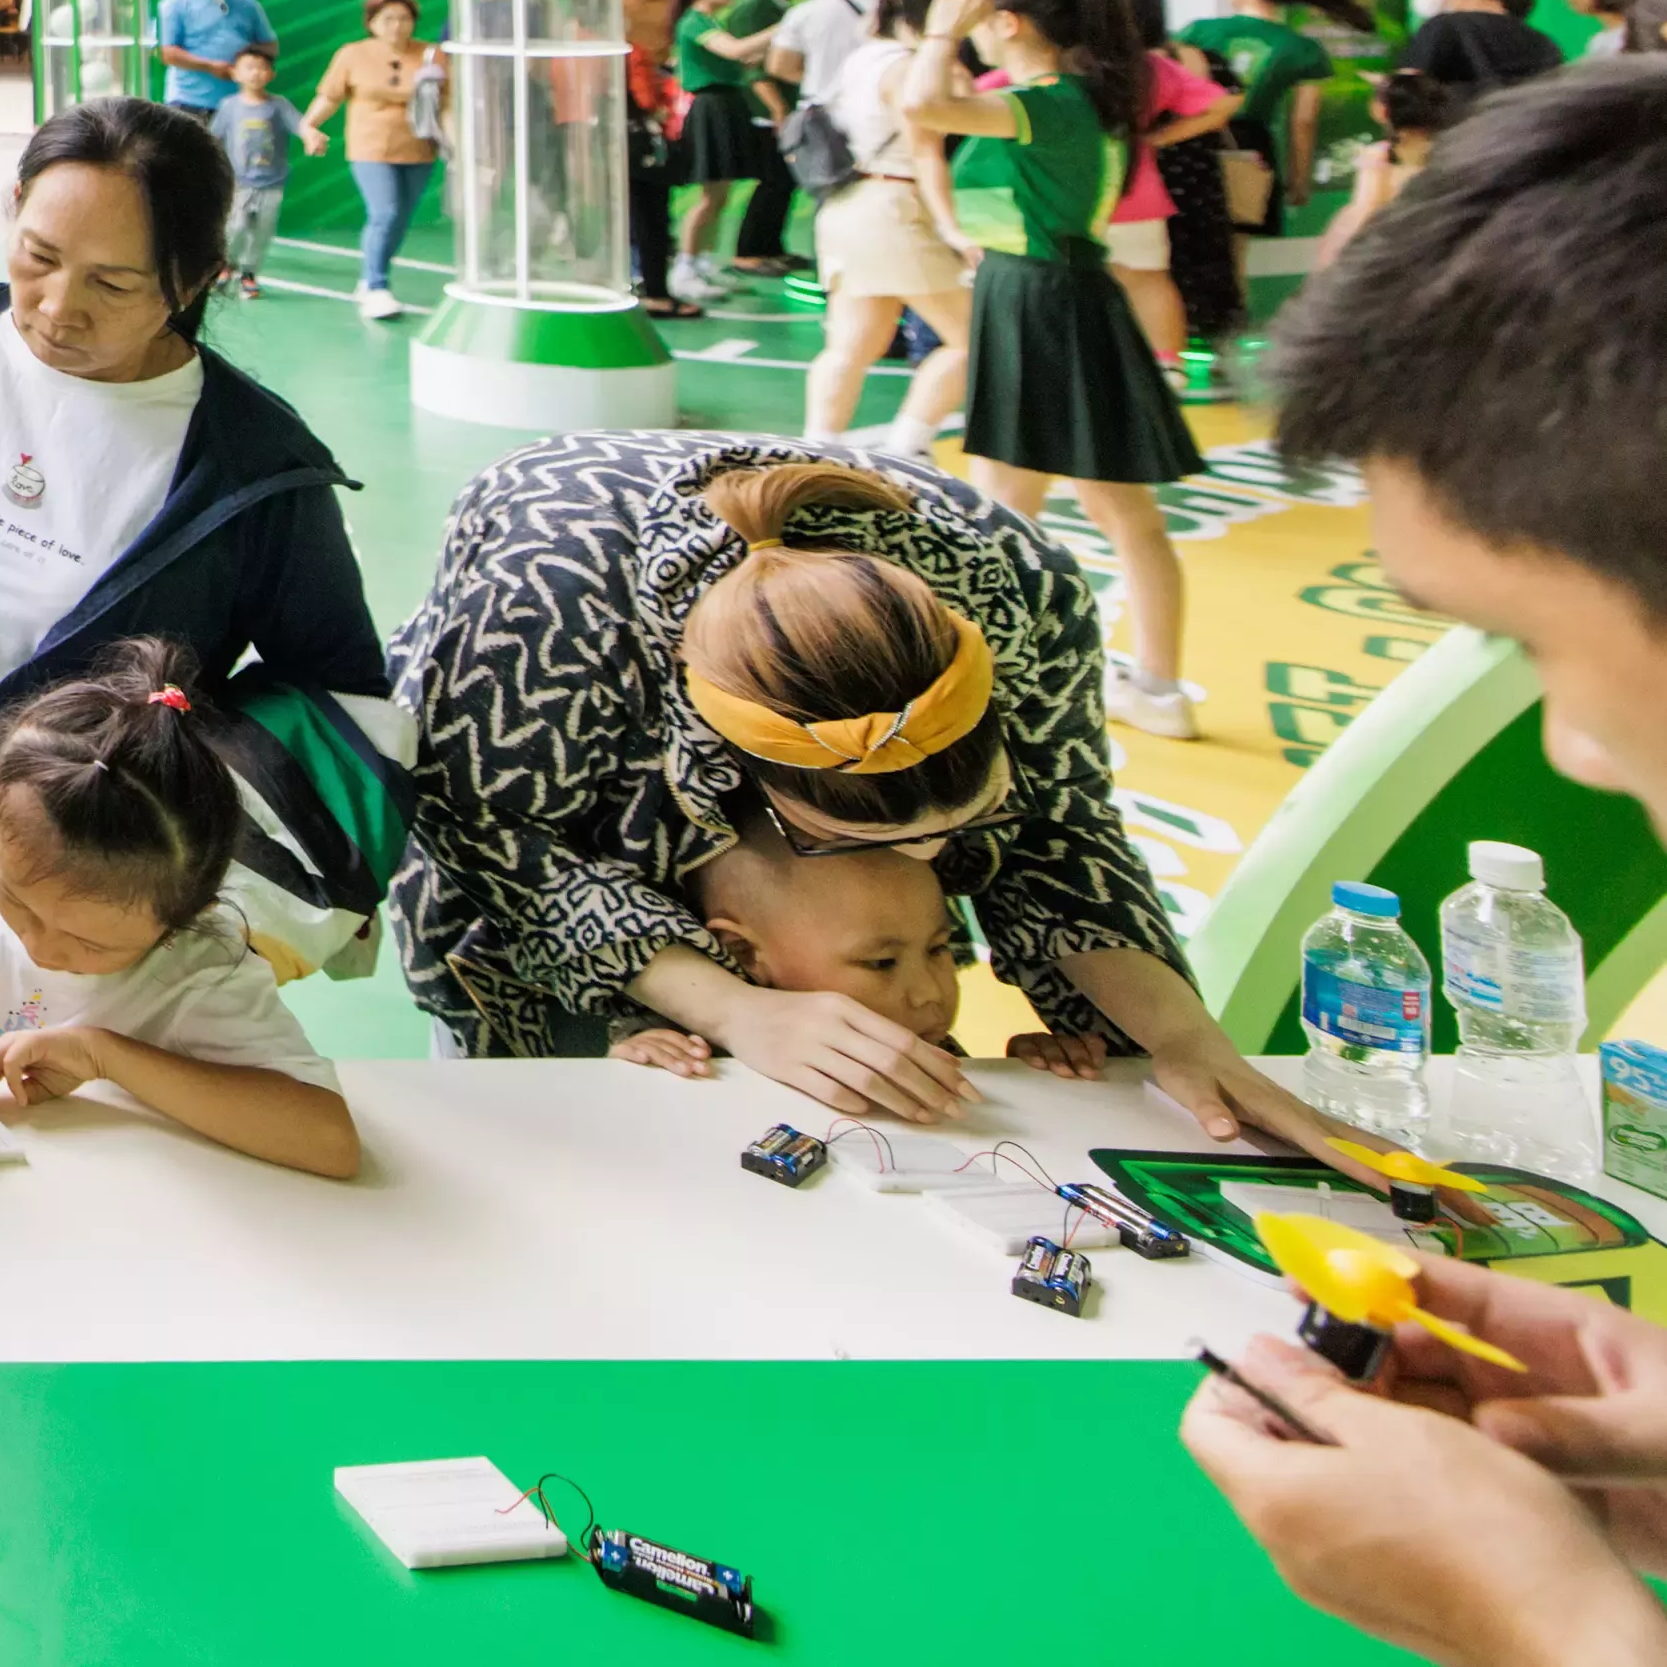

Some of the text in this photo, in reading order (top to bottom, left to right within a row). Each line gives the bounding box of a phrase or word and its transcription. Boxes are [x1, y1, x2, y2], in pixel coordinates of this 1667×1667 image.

[7, 522, 38, 543] piece
[41, 539, 56, 551] of
[629, 1537, 710, 1576] Camelion
